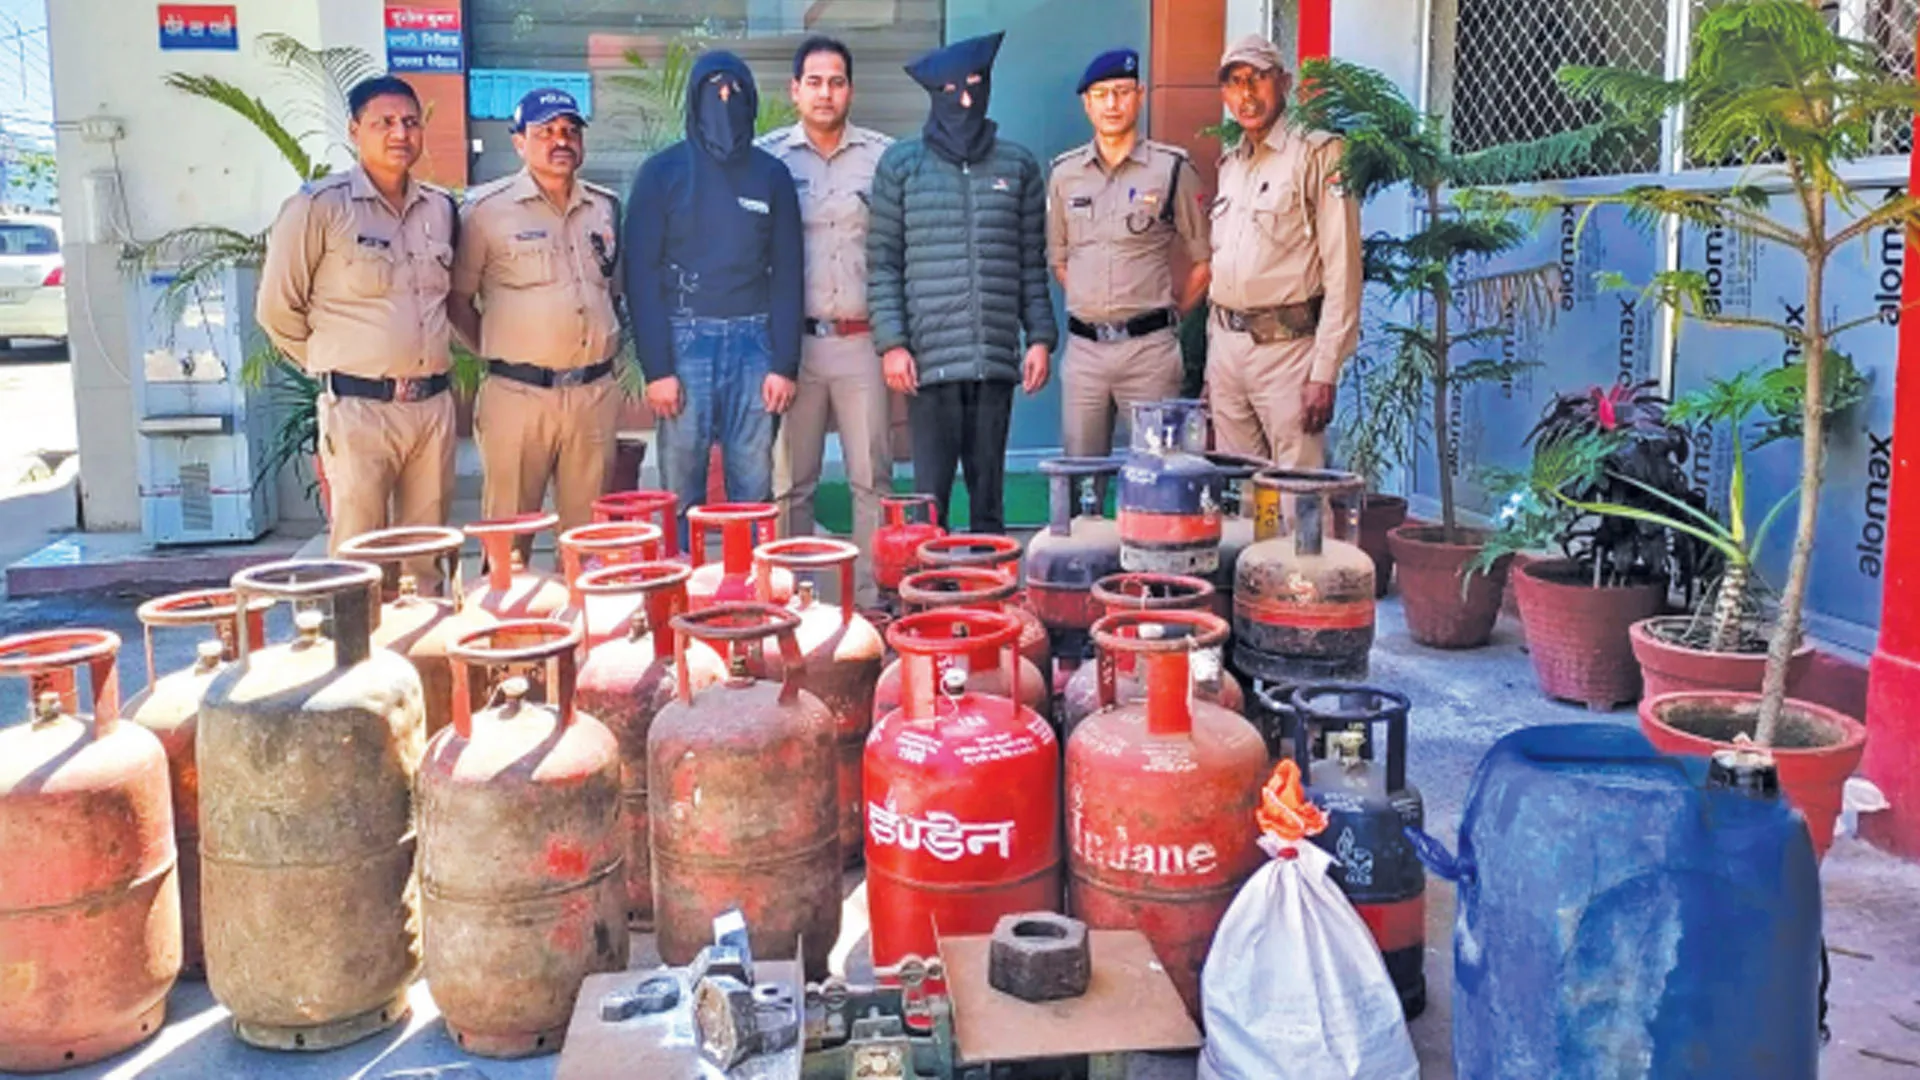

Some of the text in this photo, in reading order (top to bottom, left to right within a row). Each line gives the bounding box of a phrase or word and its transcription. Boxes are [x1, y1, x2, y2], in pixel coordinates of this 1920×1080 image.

[1560, 204, 1575, 312] alomax
[1616, 297, 1636, 389] omax
[1856, 432, 1892, 579] alomax
